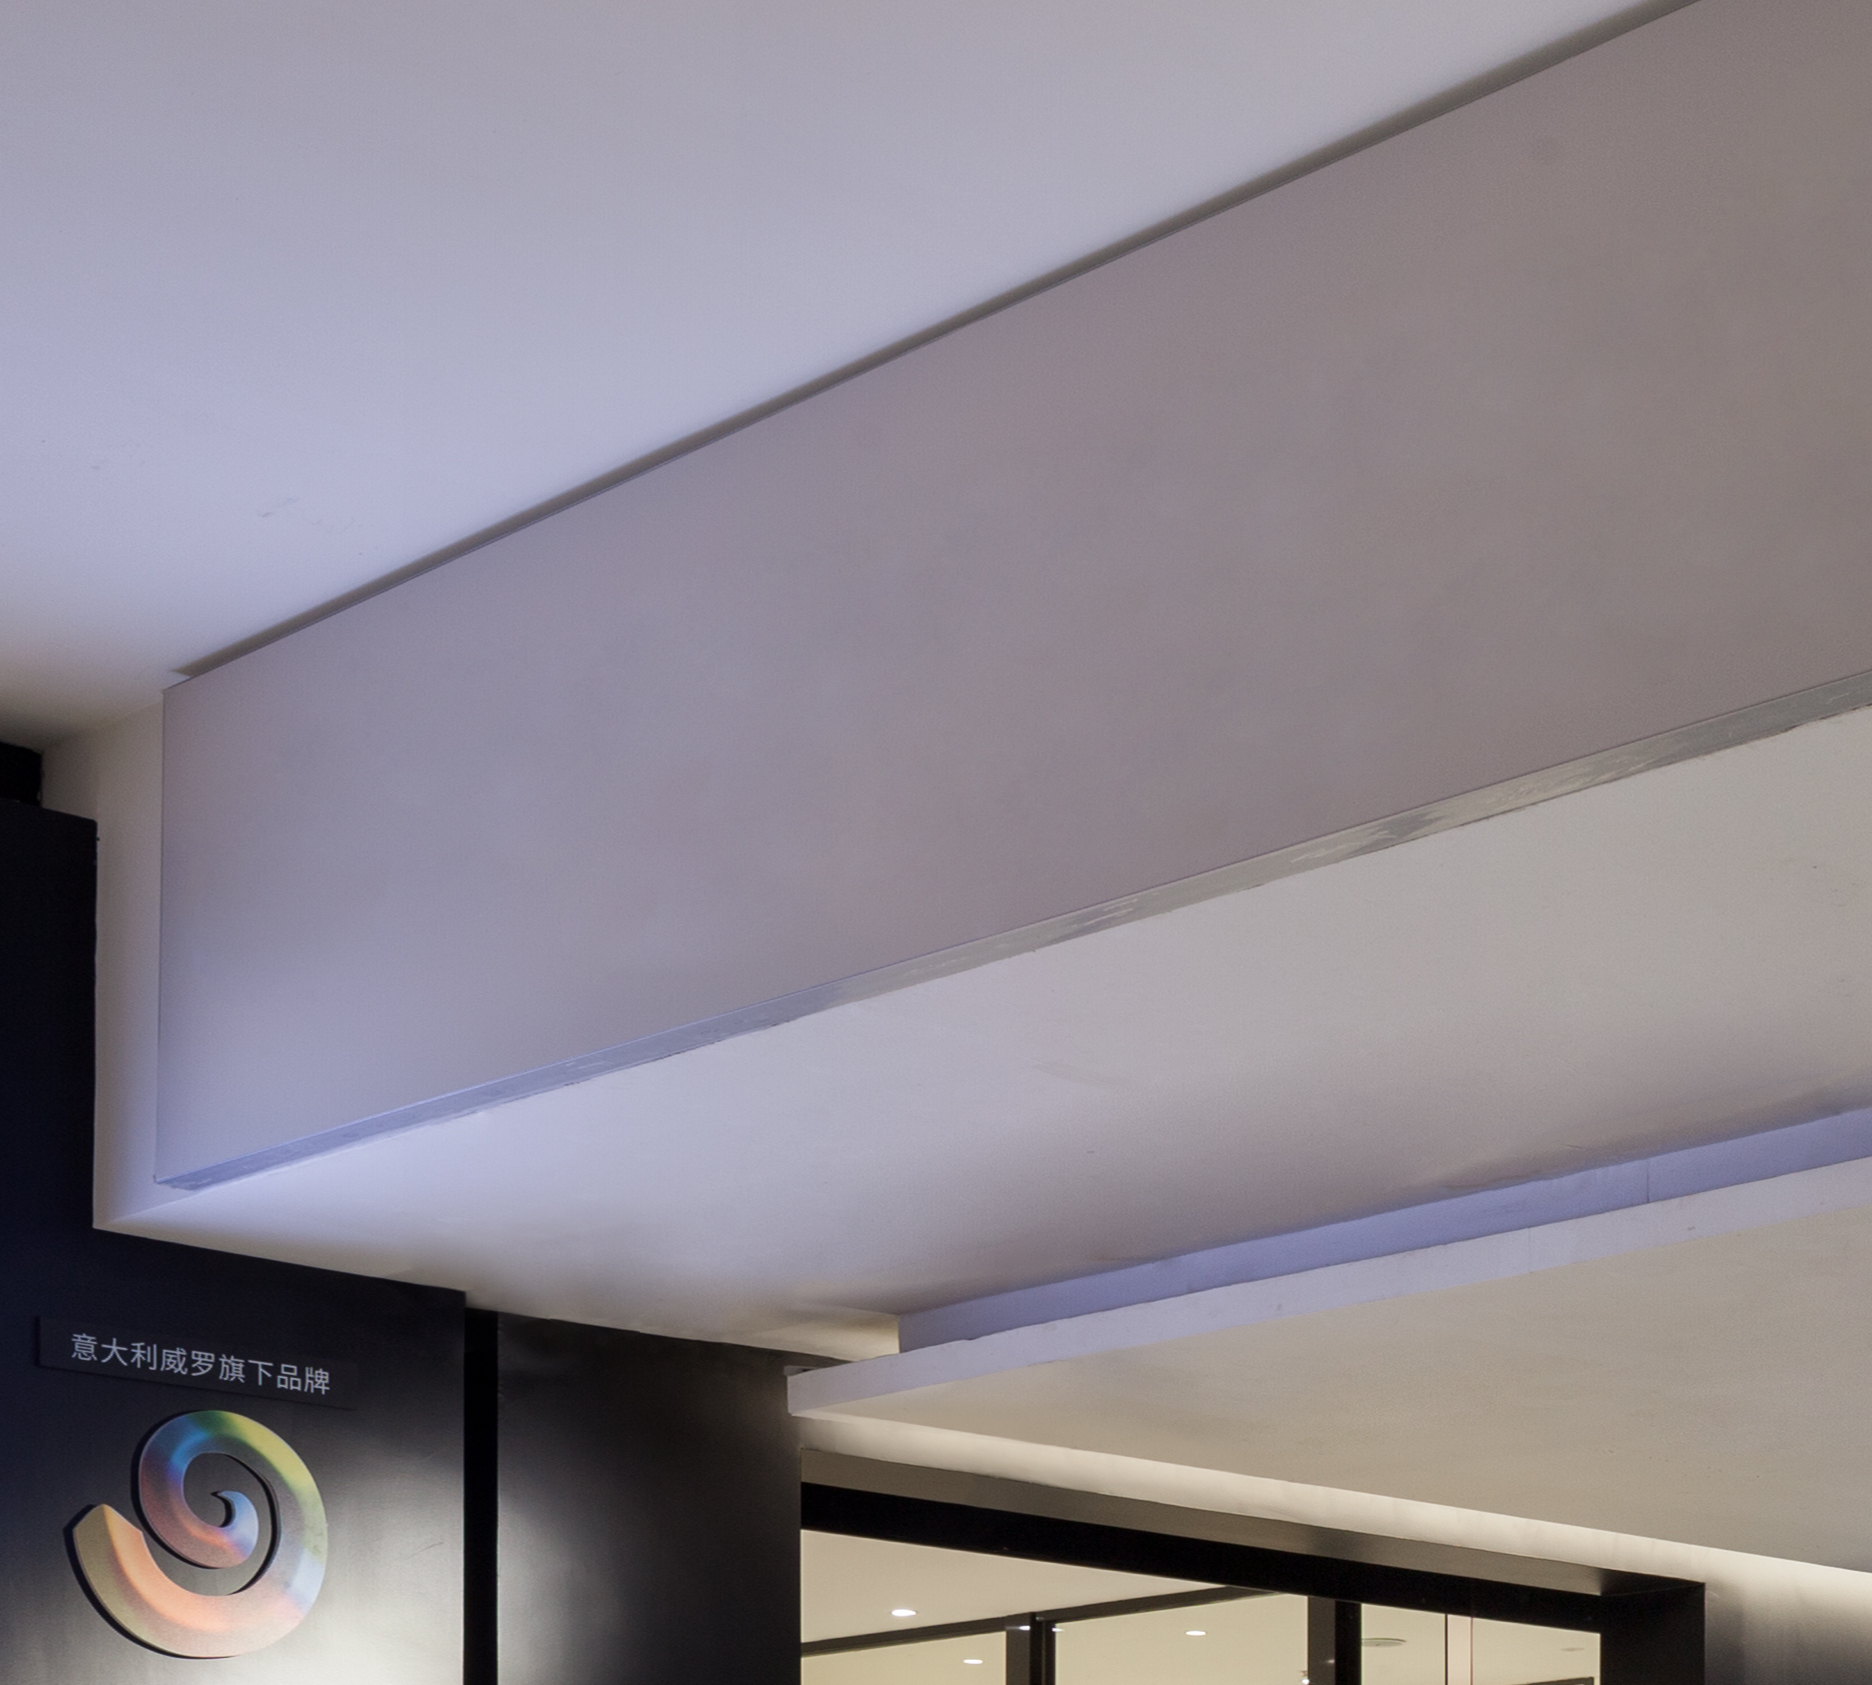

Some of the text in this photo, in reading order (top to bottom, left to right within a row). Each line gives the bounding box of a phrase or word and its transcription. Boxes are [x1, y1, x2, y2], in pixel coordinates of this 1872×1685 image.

[70, 1332, 331, 1396] 意大利威罗旗下品牌
